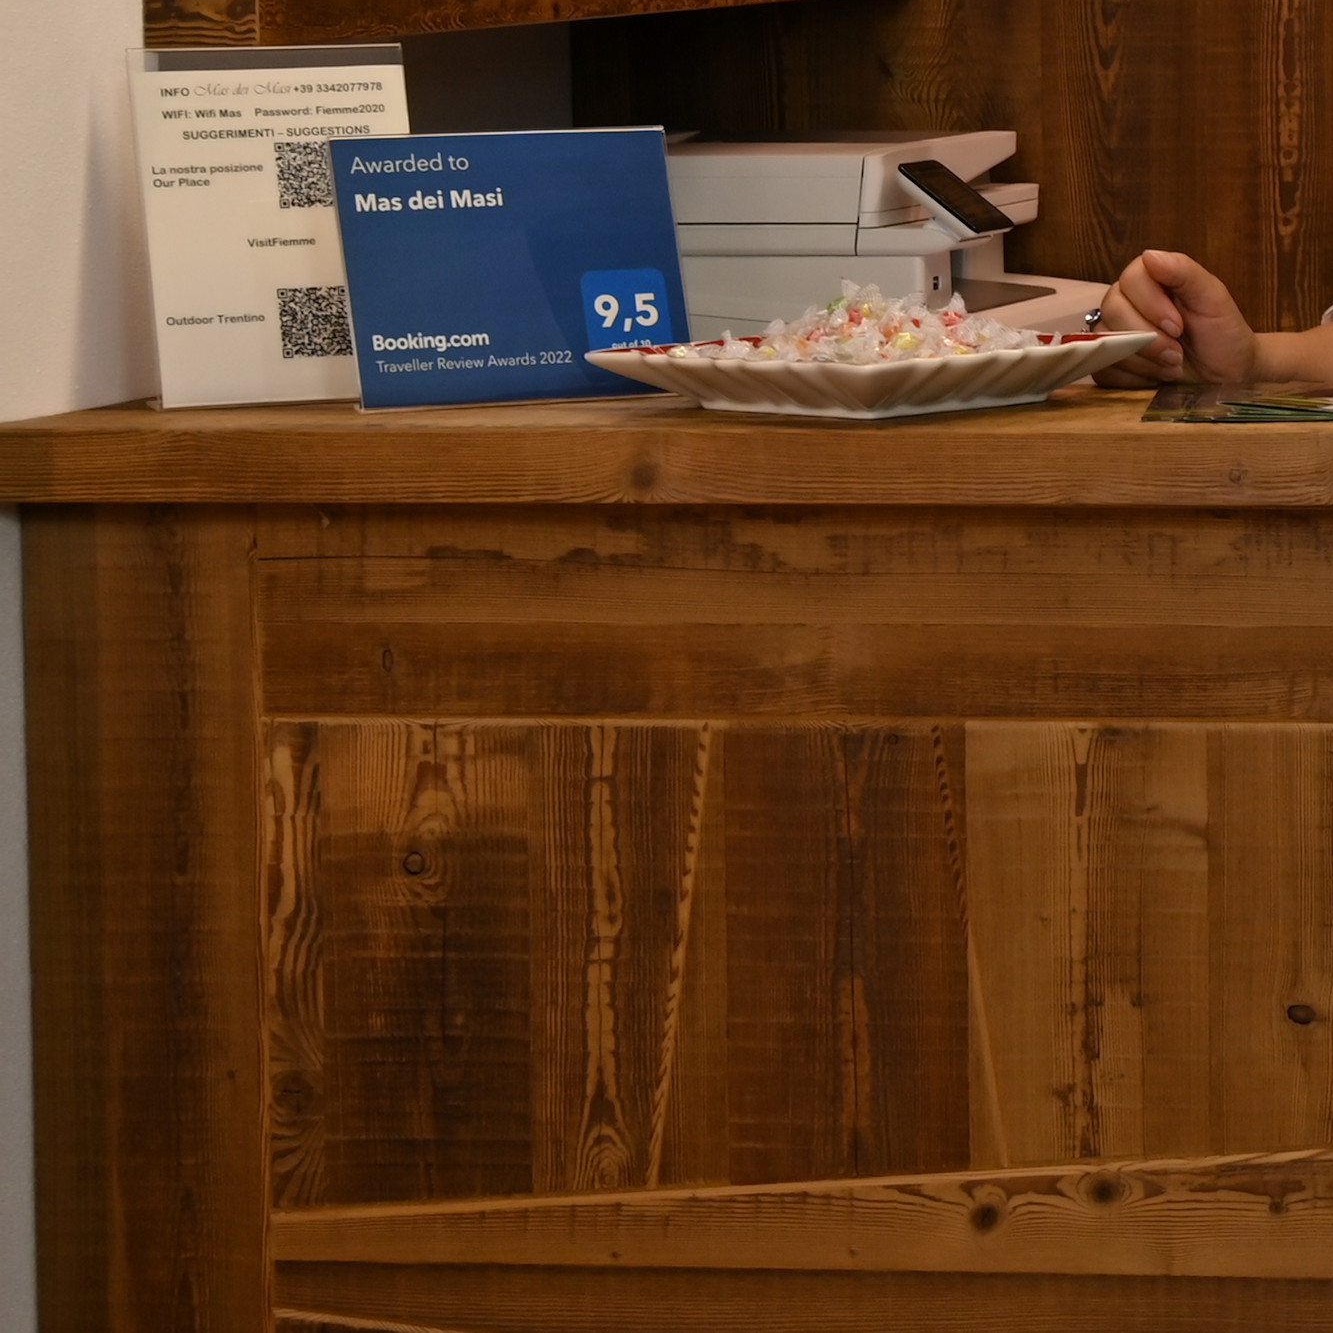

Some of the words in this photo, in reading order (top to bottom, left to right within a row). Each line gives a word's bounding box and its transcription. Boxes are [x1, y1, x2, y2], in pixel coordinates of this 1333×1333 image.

[160, 87, 190, 98] INFO
[293, 84, 313, 94] +39
[315, 81, 383, 93] 3342077978
[162, 109, 192, 120] WIFI:
[194, 108, 217, 119] Wifi
[219, 108, 242, 118] Mas
[254, 106, 313, 117] Password:
[315, 104, 385, 115] Fiemme2020
[182, 128, 275, 141] SUGGERIMENTI
[286, 125, 371, 137] SUGGESTIONS
[152, 166, 166, 176] La
[169, 164, 207, 175] nostra
[209, 163, 264, 175] posizione
[350, 152, 442, 175] Awarded
[448, 154, 470, 171] to
[153, 178, 175, 188] Our
[178, 177, 211, 188] Place
[354, 191, 403, 213] Mas
[407, 189, 445, 210] dei
[450, 187, 504, 209] Masi
[247, 237, 317, 248] VisitFiemme
[166, 315, 214, 326] Outdoor
[217, 313, 266, 325] Trentino
[593, 292, 660, 333] 9,5
[372, 331, 490, 353] Booking.com
[376, 359, 434, 374] Traveller
[437, 357, 484, 371] Review
[487, 355, 537, 369] Awards
[540, 349, 573, 365] 2022
